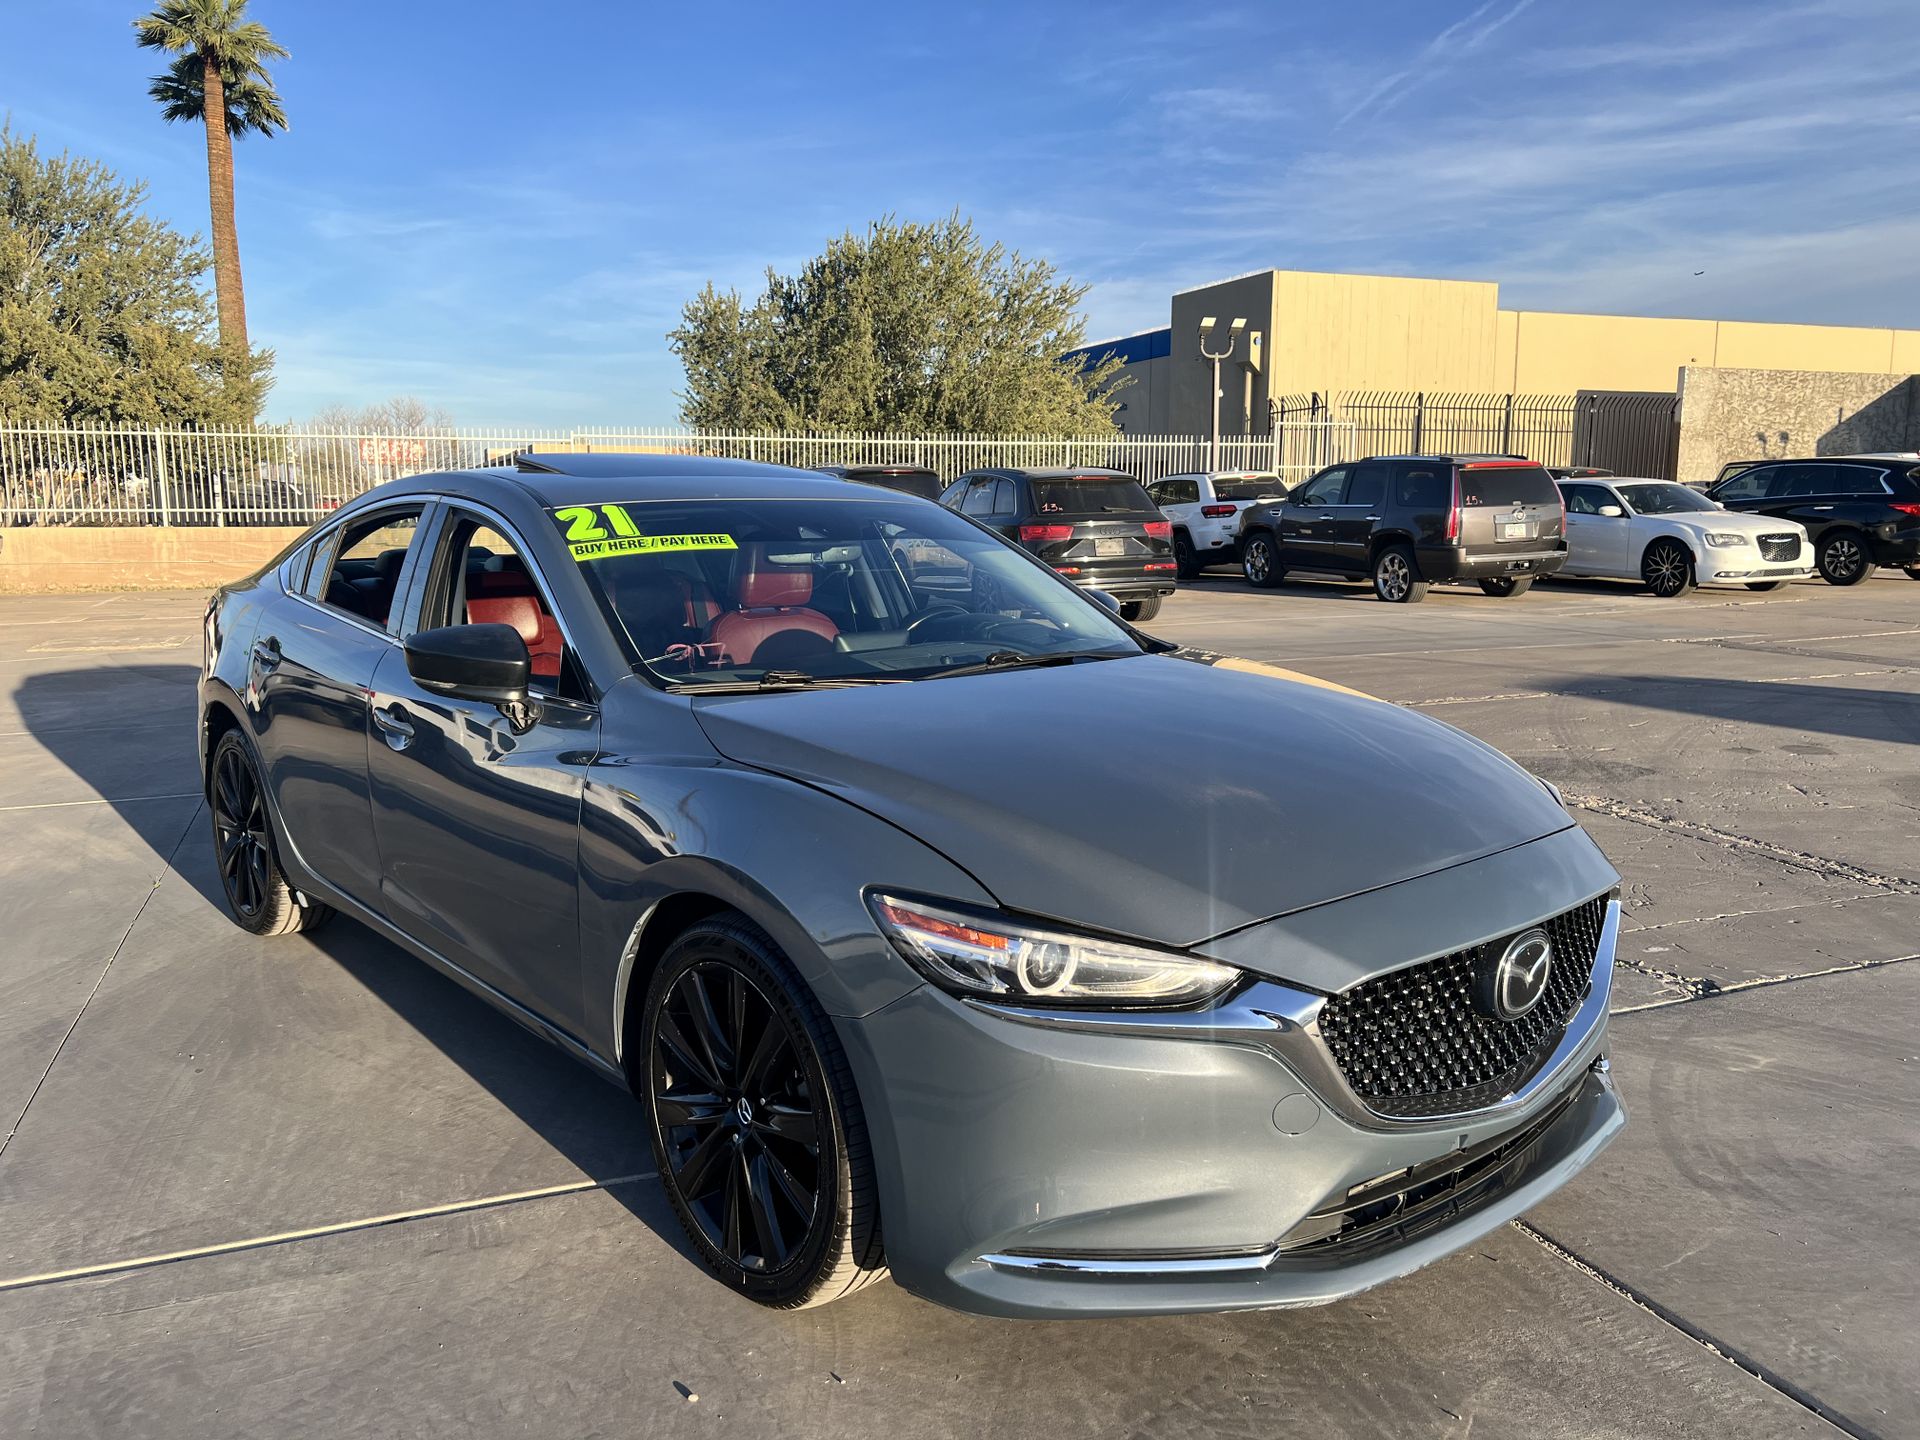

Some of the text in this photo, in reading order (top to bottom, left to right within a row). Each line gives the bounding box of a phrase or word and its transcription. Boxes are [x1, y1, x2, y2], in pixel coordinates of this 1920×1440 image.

[554, 504, 641, 542] 21
[575, 543, 604, 556] BUY
[608, 538, 646, 551] HERE
[660, 536, 686, 548] PAY
[691, 535, 727, 546] HERE
